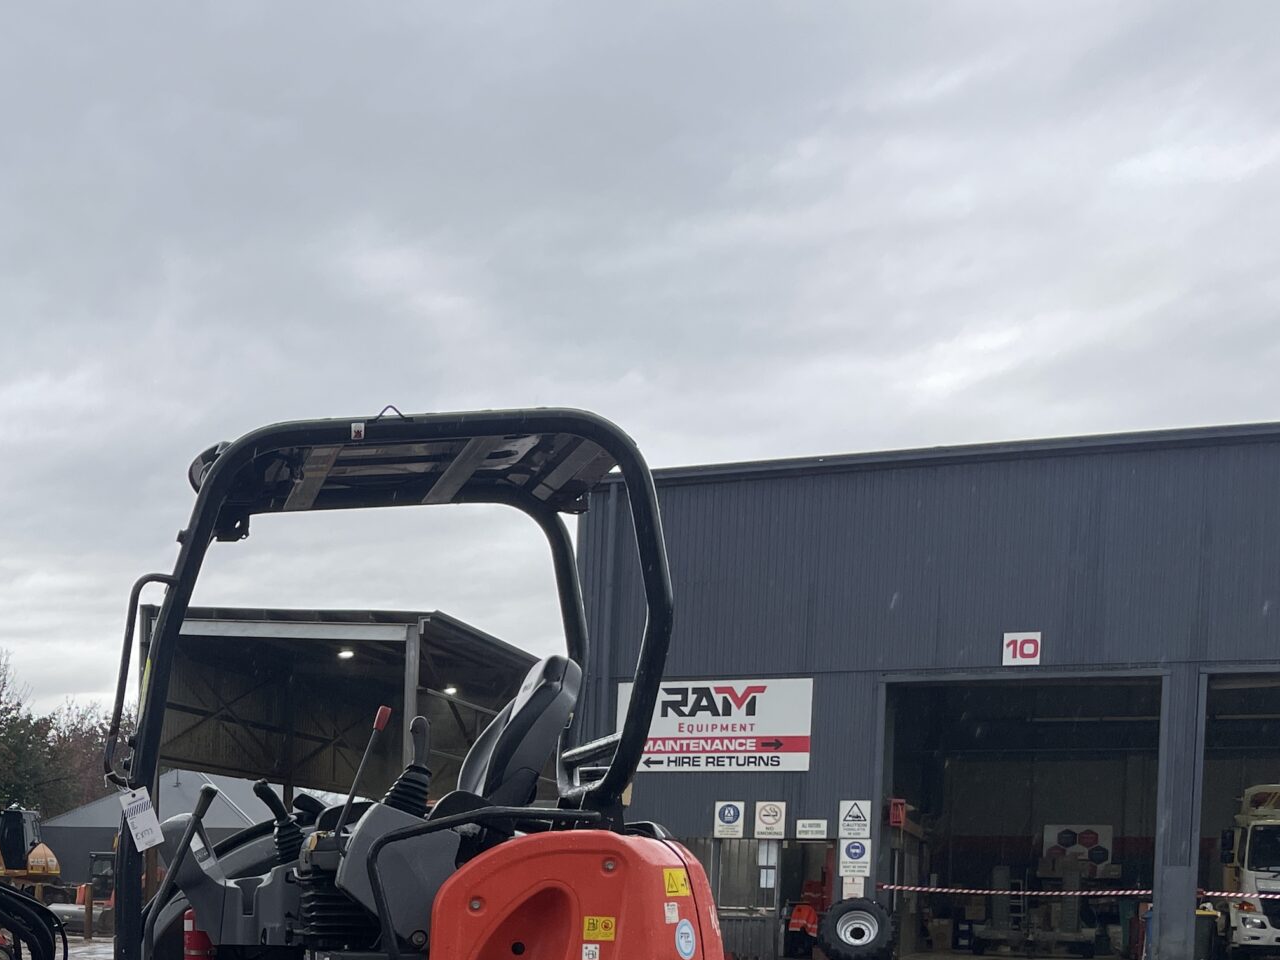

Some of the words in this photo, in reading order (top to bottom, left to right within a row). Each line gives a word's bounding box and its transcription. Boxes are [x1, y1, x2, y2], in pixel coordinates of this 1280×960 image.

[1006, 638, 1039, 659] 10
[660, 686, 767, 717] RAM
[644, 739, 756, 752] MAINTENANCE
[667, 757, 701, 767] HIRE
[705, 756, 780, 767] RETURNS
